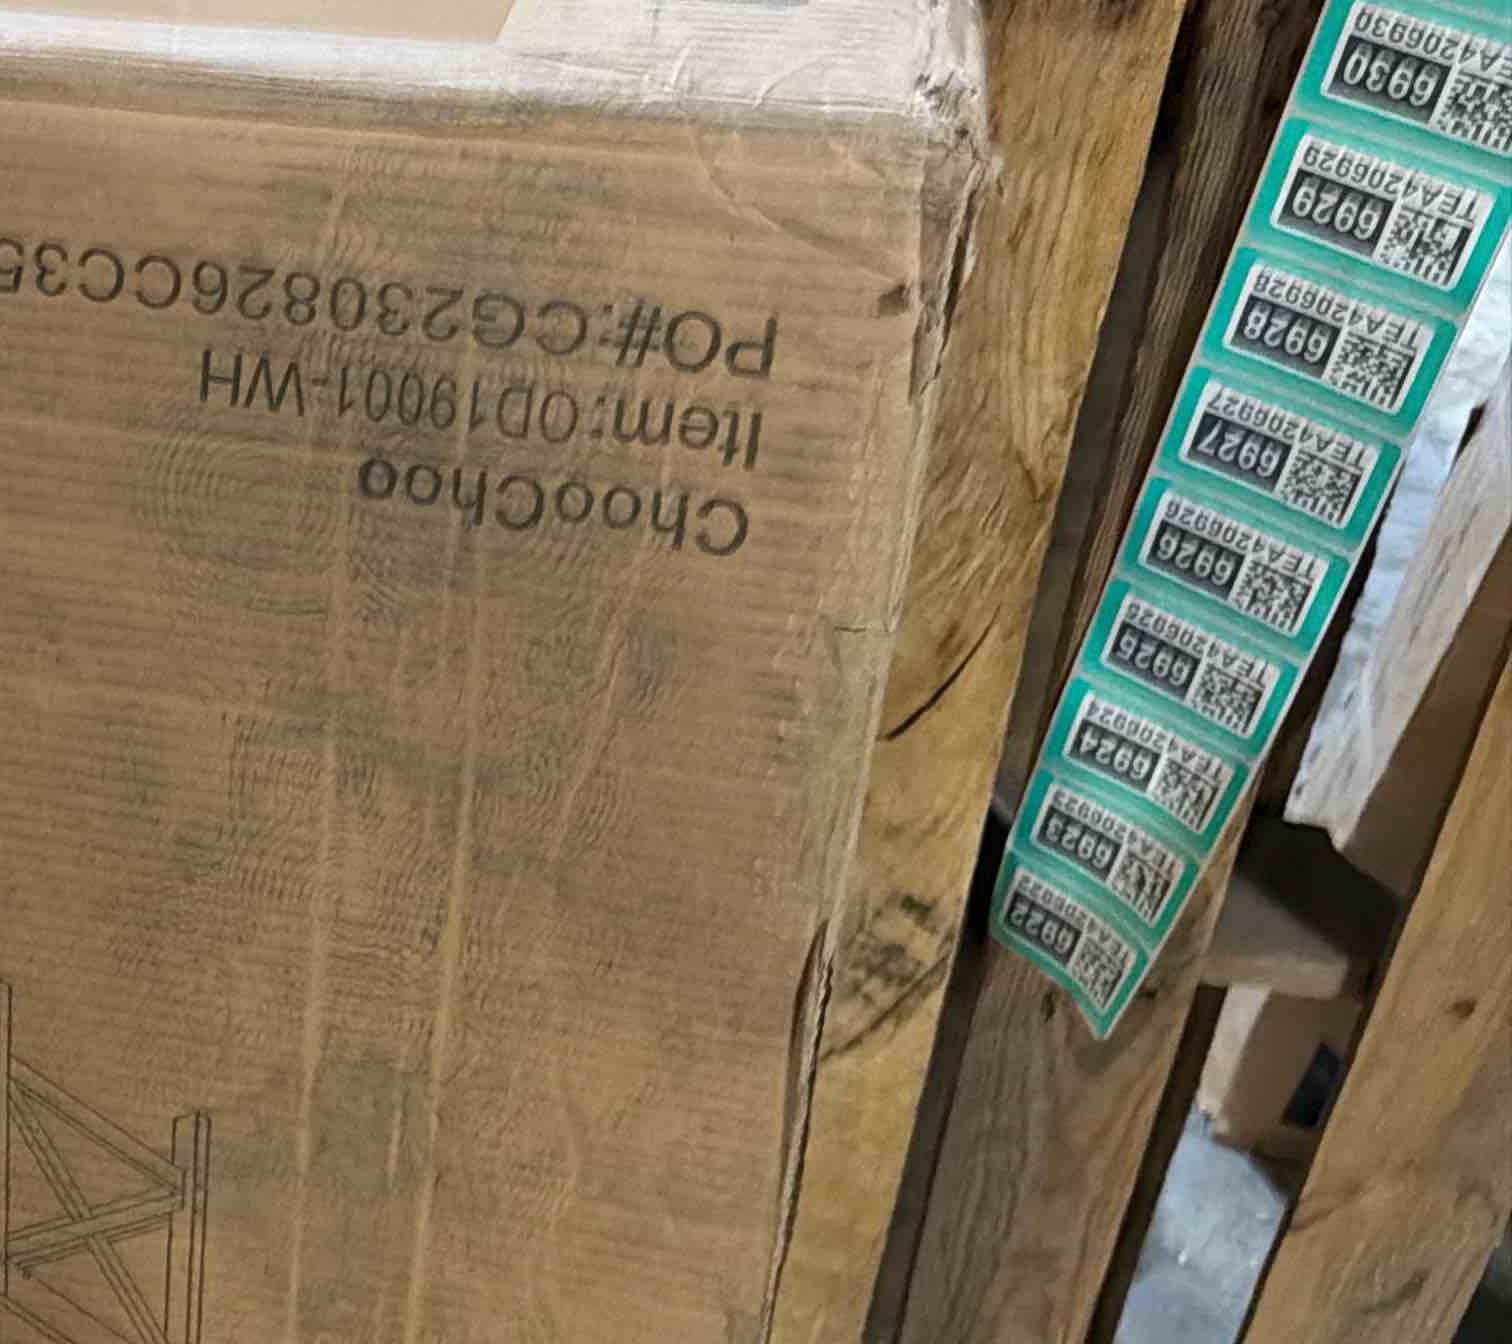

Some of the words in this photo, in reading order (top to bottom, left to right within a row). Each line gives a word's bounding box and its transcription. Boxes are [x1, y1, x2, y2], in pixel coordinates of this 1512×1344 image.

[1343, 43, 1441, 106] 6930
[1292, 174, 1384, 240] 6929
[1304, 145, 1479, 223] TEA4206929
[1243, 303, 1331, 362] 6928
[1254, 269, 1425, 349] TEA4206928
[1197, 419, 1282, 477] 6927
[1208, 389, 1367, 469] TEA4206927
[360, 457, 748, 557] ChooChoo
[1165, 500, 1315, 577] TEA4206926
[1159, 529, 1236, 586] 6926
[1118, 631, 1189, 686] 6925
[1127, 602, 1269, 686] TEA4206925
[1080, 729, 1152, 779] 6924
[1046, 814, 1113, 869] 6923
[1010, 900, 1076, 951] 6922
